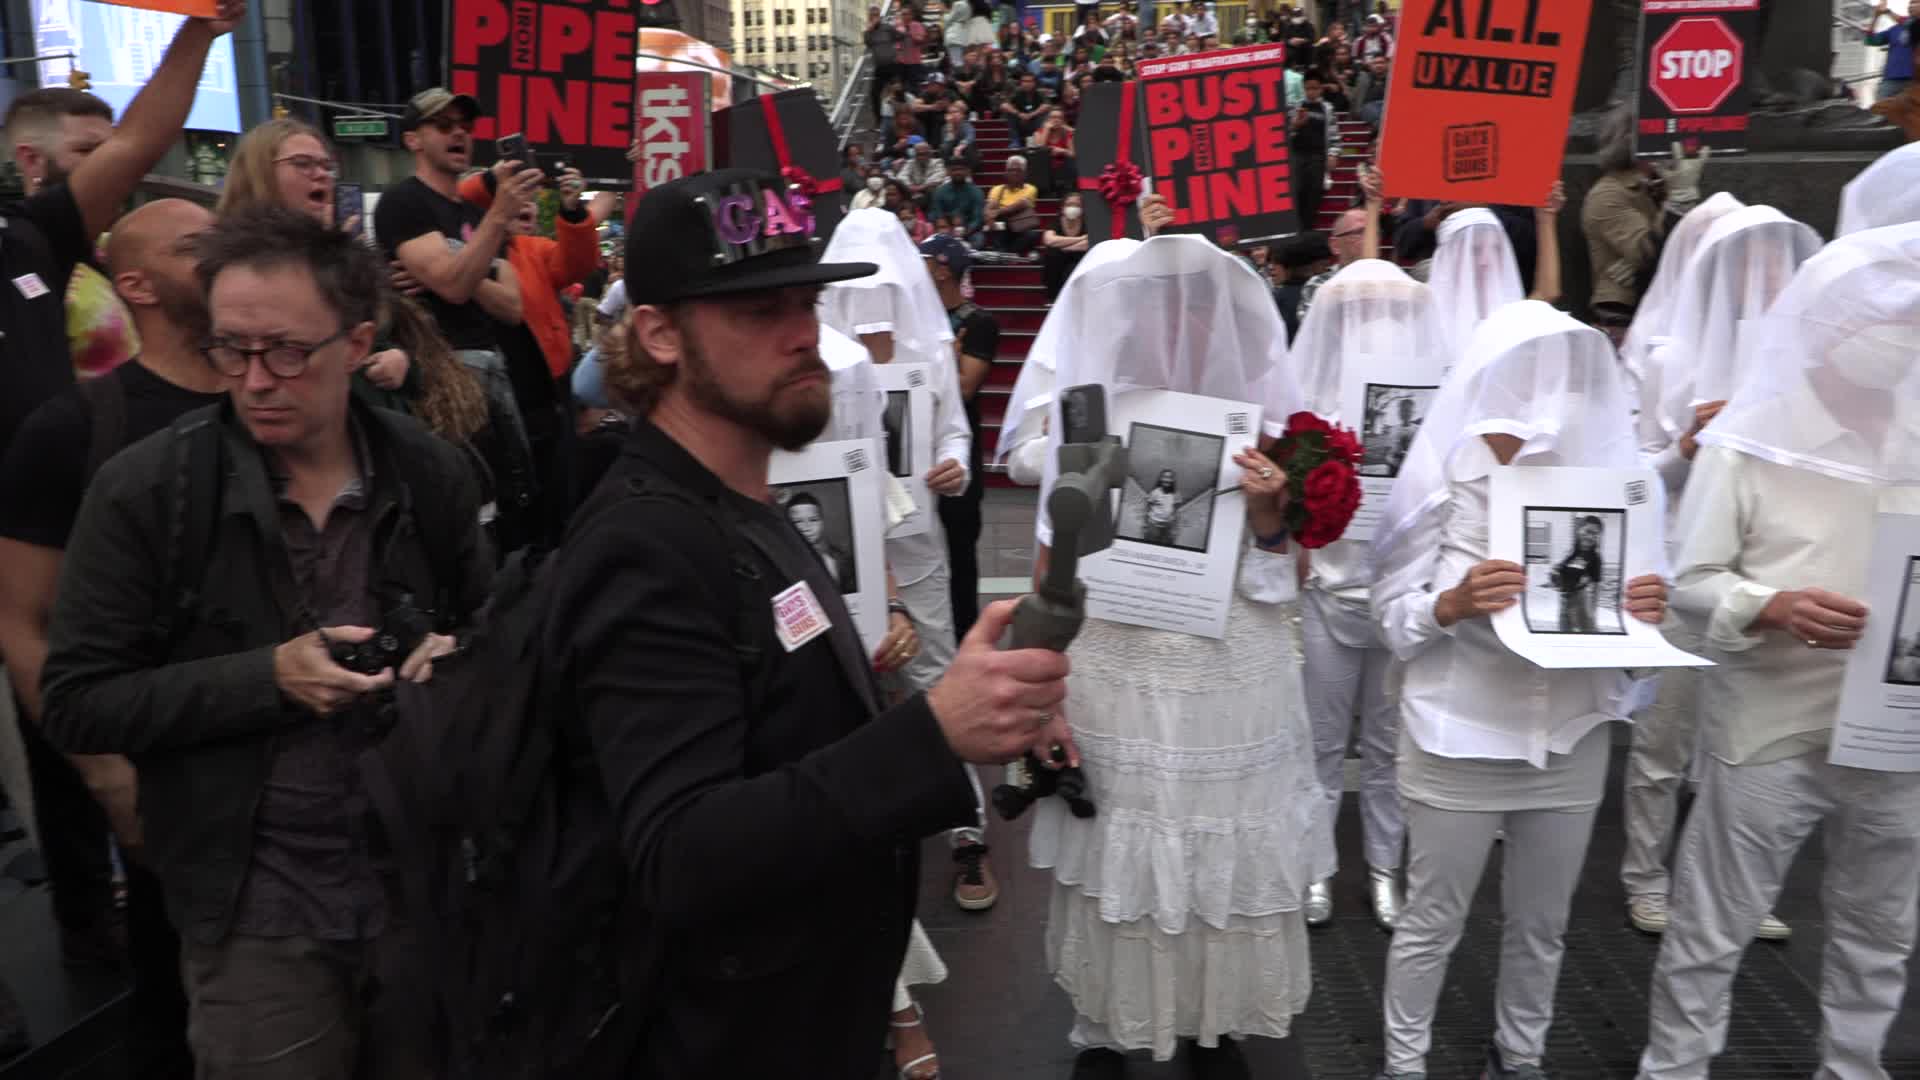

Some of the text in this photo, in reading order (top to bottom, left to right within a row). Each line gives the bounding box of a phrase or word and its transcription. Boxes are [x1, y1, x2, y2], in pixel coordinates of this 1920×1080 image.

[453, 0, 637, 79] PIPE
[515, 7, 532, 64] IRON
[1421, 0, 1561, 46] ALL
[1416, 56, 1553, 95] UVALDE
[1660, 48, 1734, 80] STOP
[453, 69, 632, 149] LINE
[1145, 66, 1282, 126] BUST
[640, 83, 692, 188] tkts
[1151, 112, 1290, 177] PIPE
[1156, 163, 1294, 226] LINE
